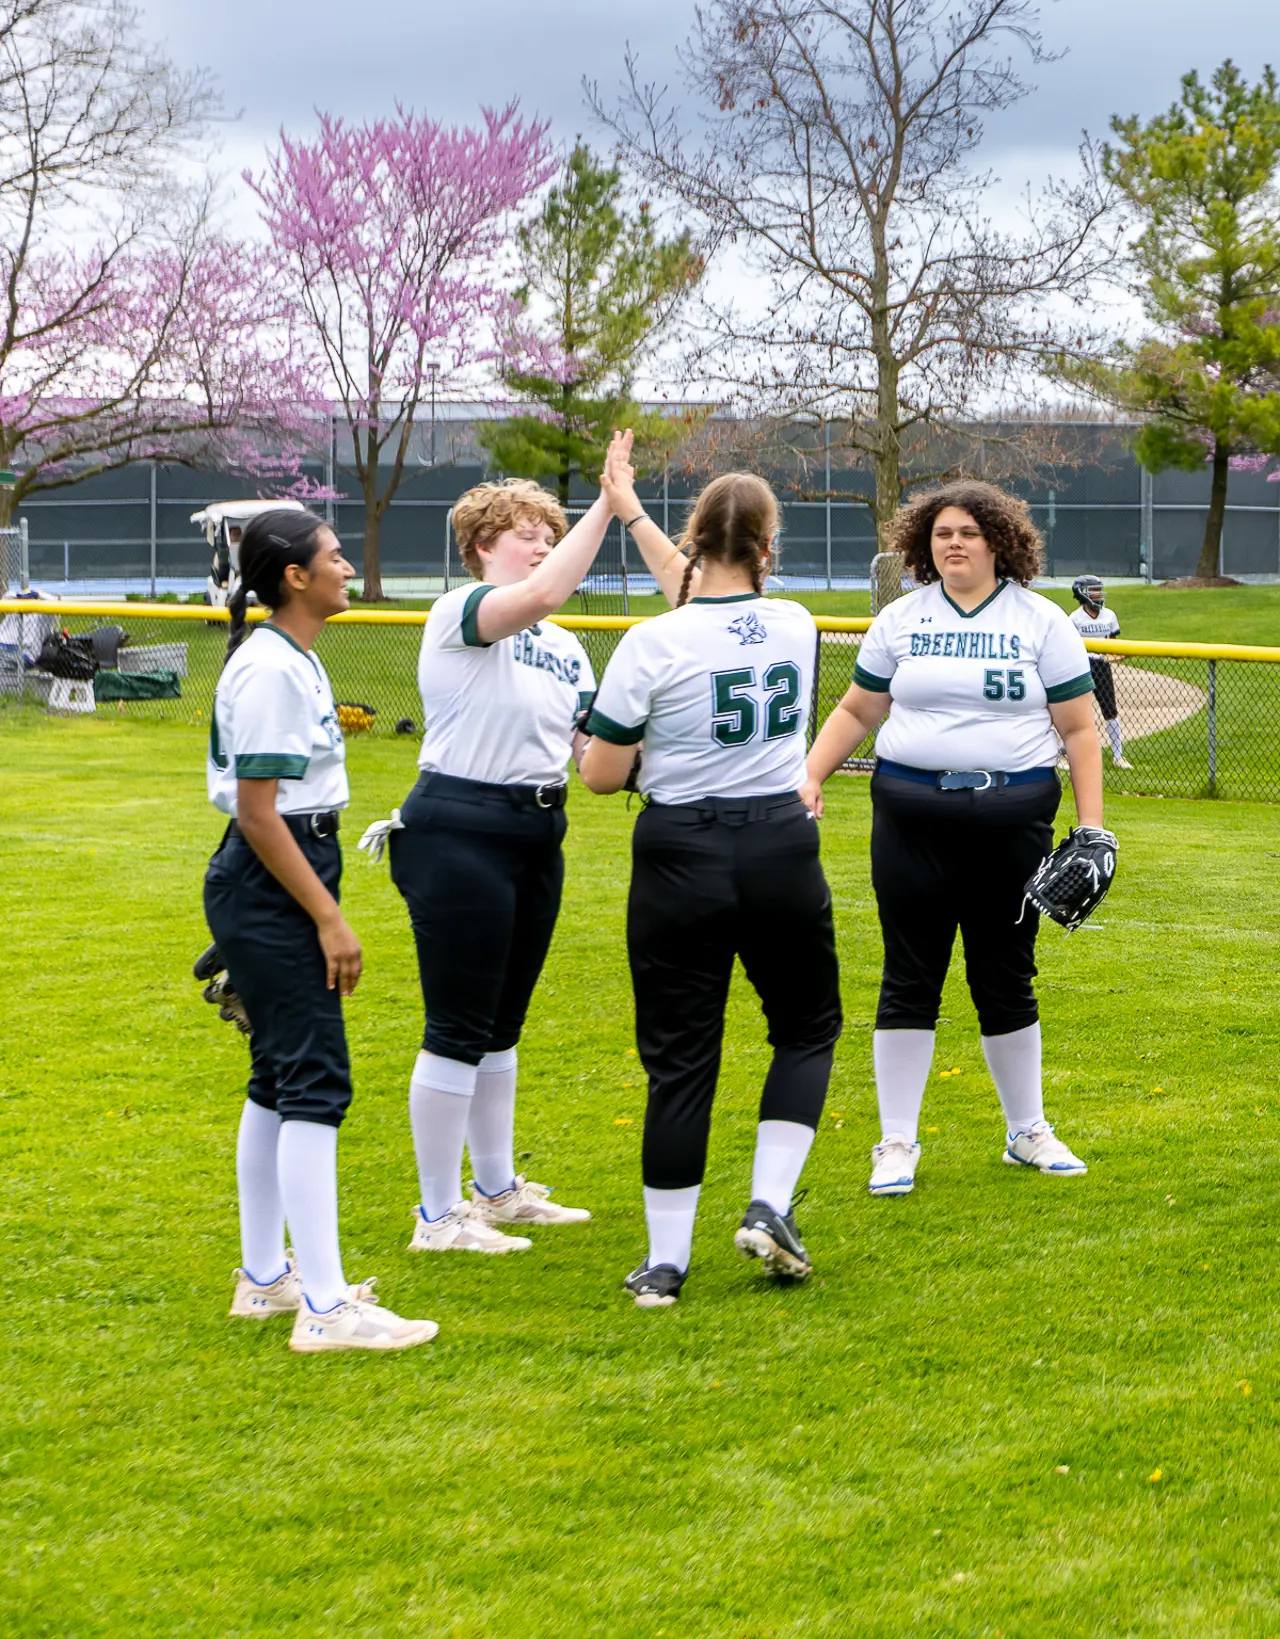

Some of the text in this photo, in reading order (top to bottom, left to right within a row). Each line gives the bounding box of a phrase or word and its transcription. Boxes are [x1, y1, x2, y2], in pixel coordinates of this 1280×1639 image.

[909, 631, 1022, 660] GREENHILLS
[983, 668, 1026, 702] 55
[710, 660, 802, 749] 52
